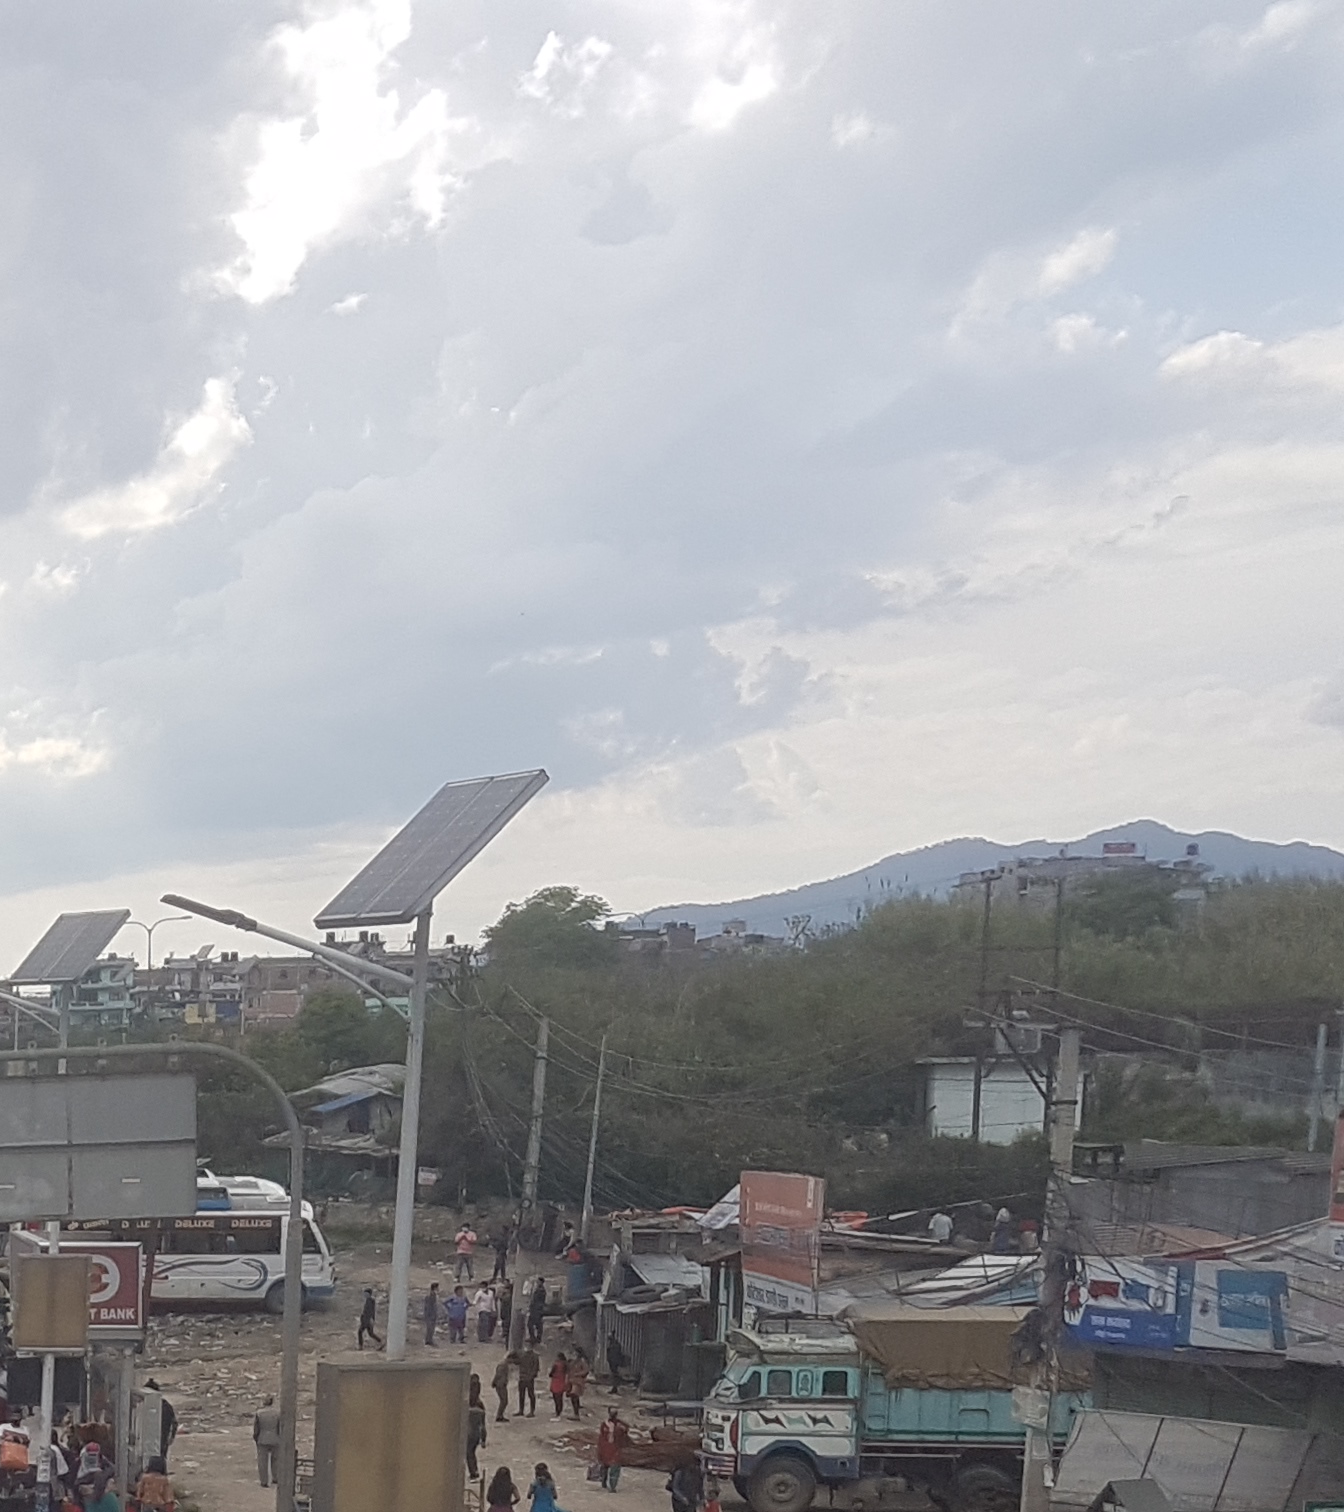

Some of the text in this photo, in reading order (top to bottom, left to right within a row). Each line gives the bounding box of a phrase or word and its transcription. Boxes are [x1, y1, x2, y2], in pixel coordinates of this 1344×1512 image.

[175, 1219, 215, 1228] DELUXE
[231, 1219, 273, 1228] DELUXE
[100, 1307, 135, 1320] BANK
